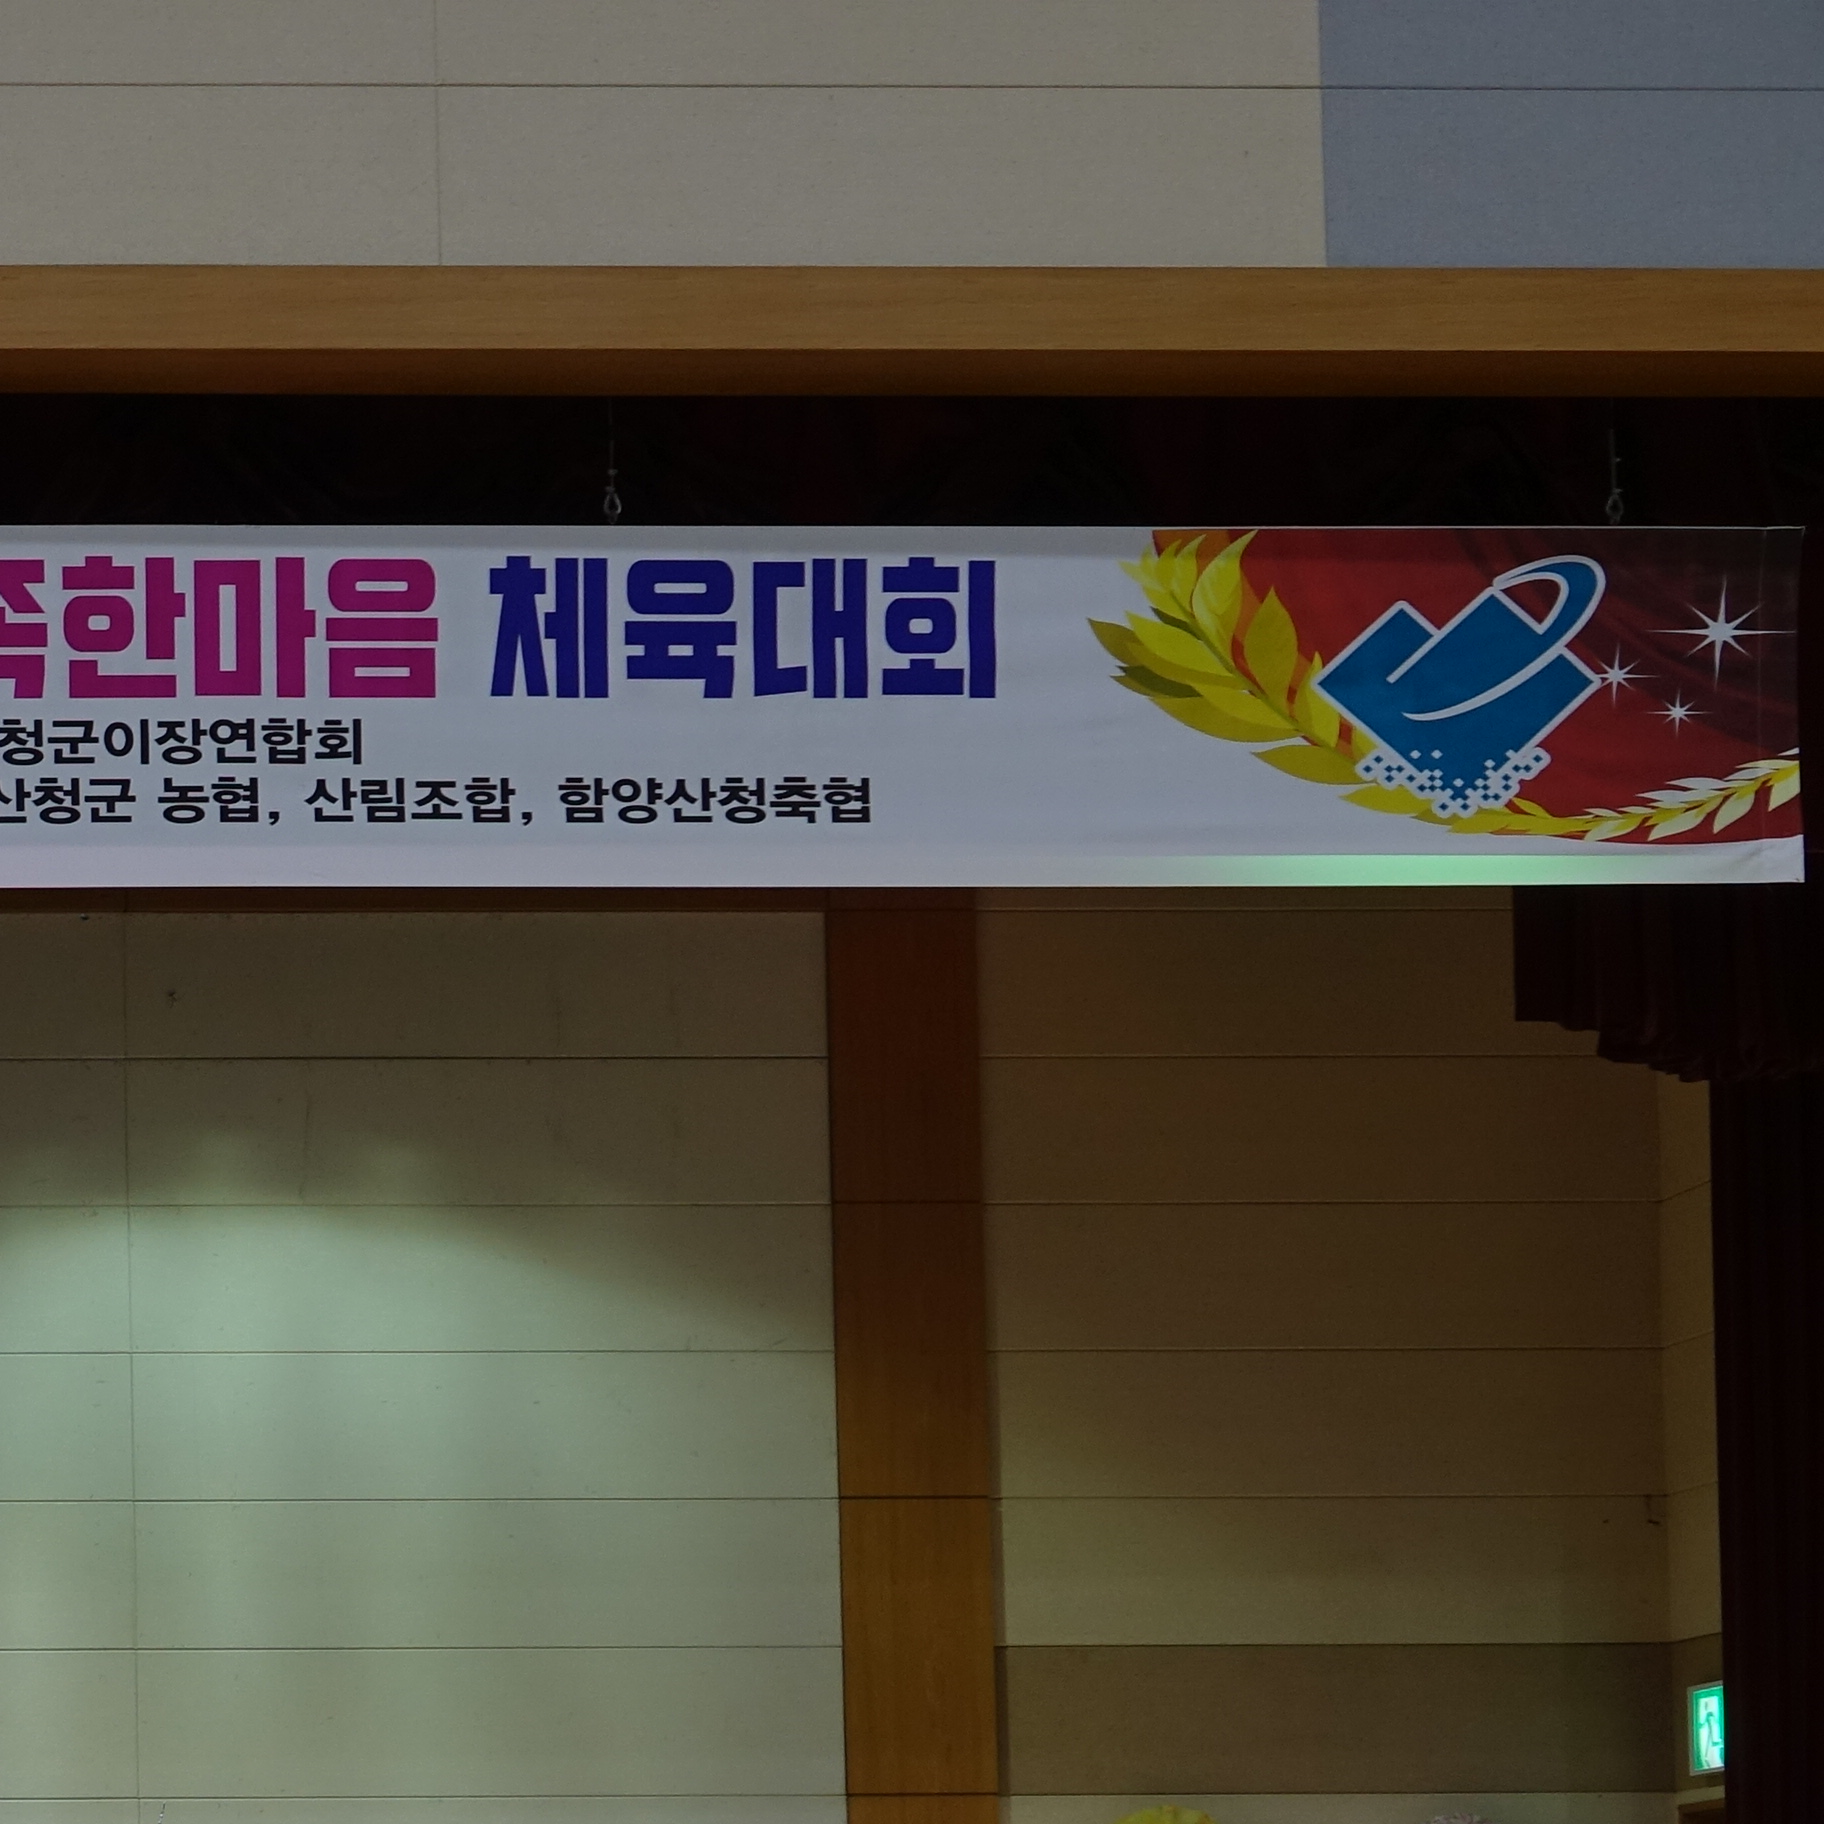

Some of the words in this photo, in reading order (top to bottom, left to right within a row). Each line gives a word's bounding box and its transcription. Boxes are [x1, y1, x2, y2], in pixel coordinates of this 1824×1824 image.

[489, 556, 998, 698] 체육대회
[158, 777, 280, 827] 농협,
[305, 777, 533, 826] 산림조합,
[559, 776, 871, 825] 함양산청축협
